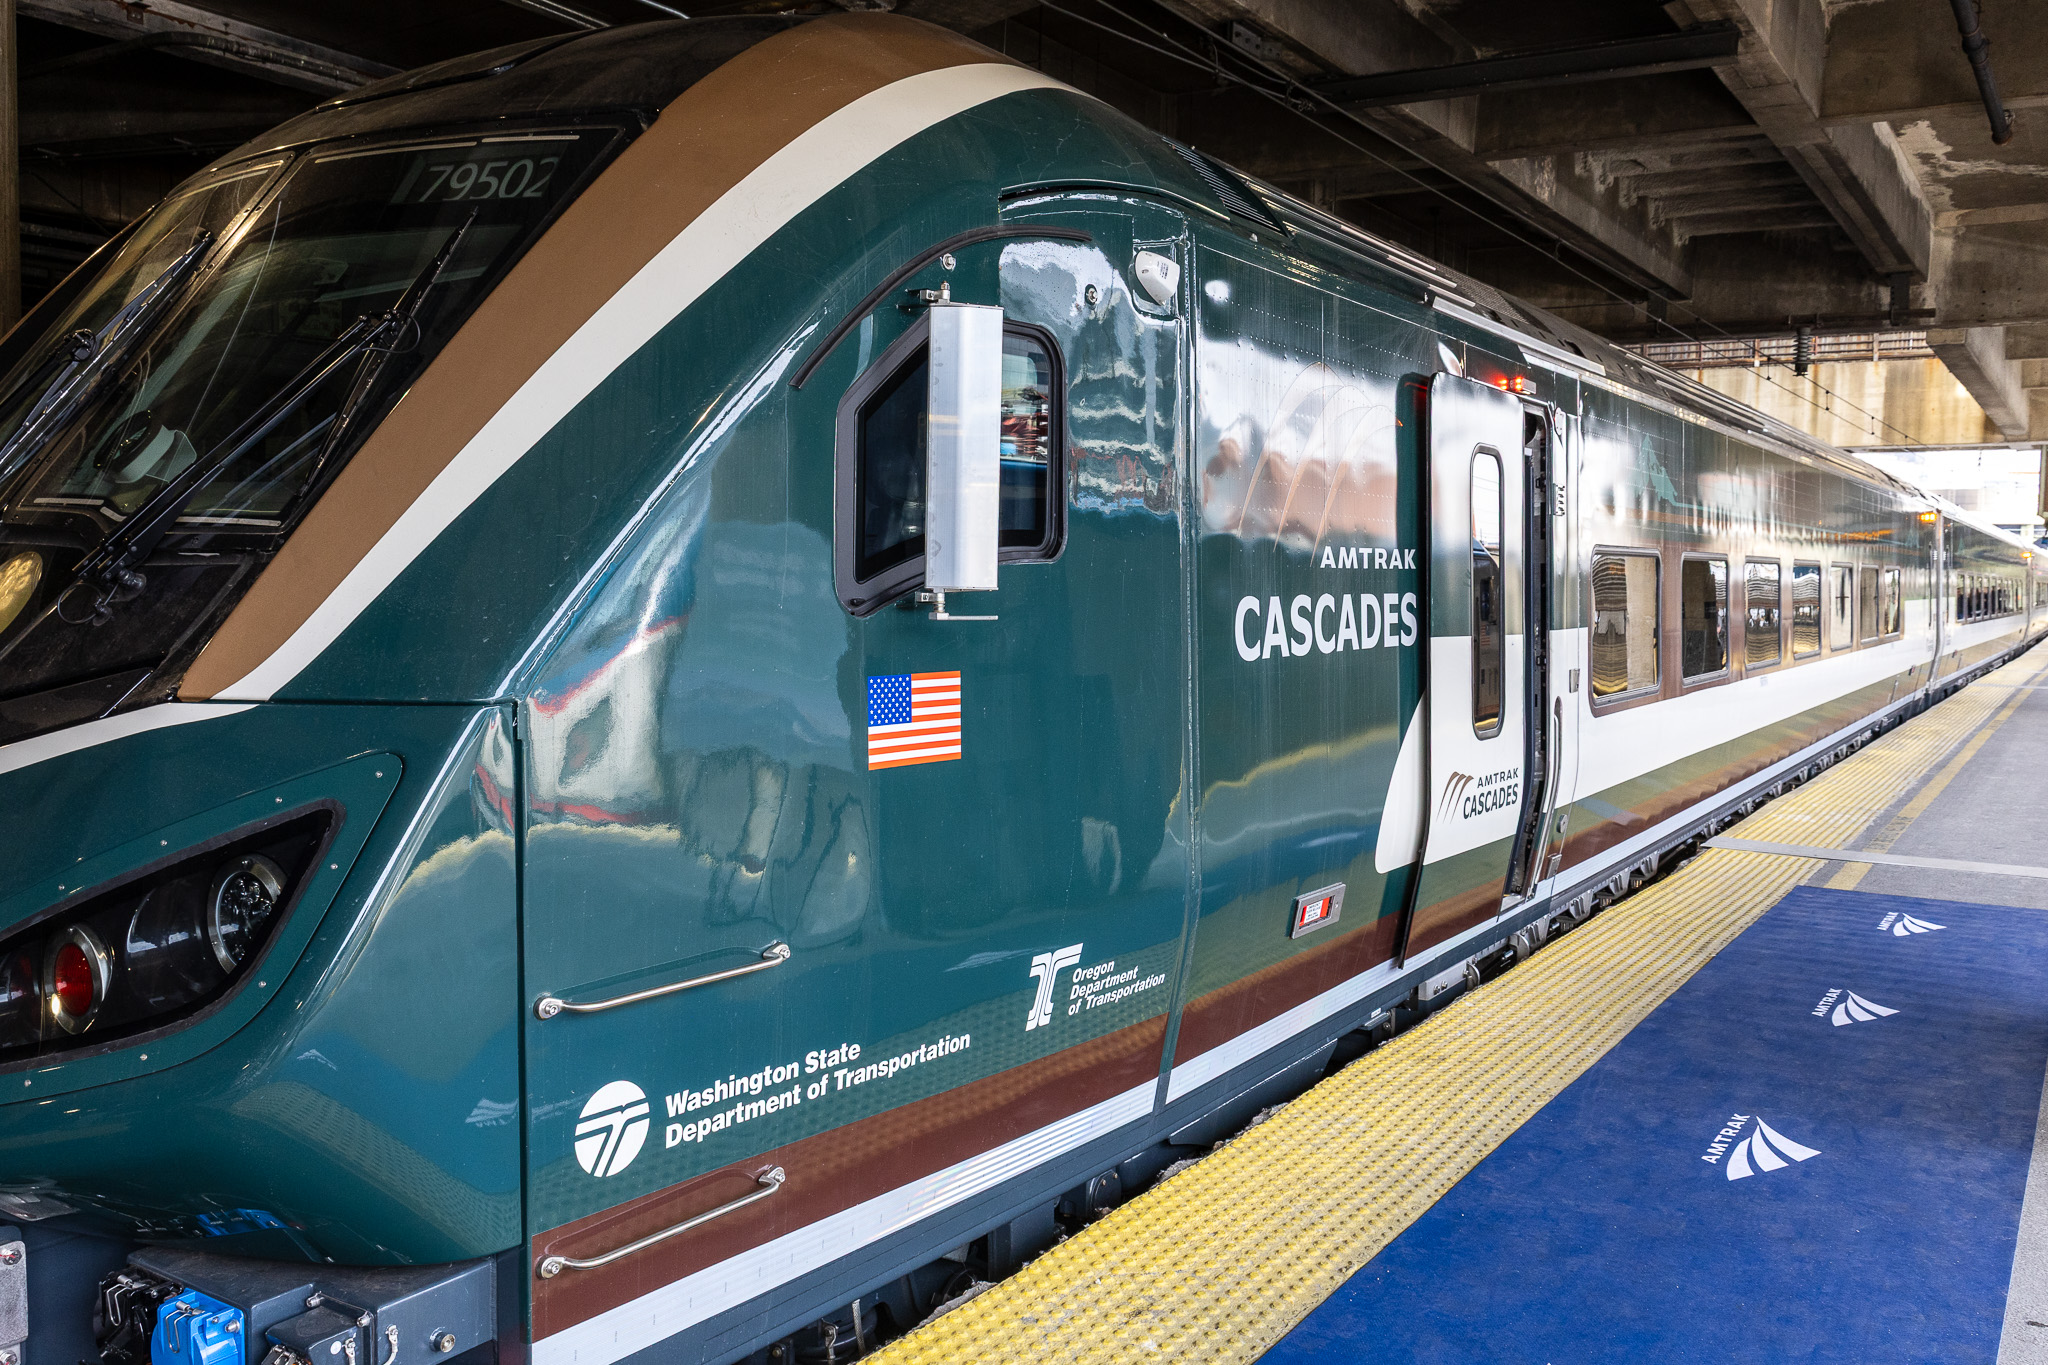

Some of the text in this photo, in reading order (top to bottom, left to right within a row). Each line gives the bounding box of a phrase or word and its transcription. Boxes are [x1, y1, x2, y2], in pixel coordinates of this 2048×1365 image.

[419, 157, 559, 202] 79502
[1320, 545, 1416, 570] AMTRAK
[1234, 591, 1418, 662] CASCADES
[1477, 767, 1519, 788] AMTRAK
[1463, 783, 1519, 820] CASCADES
[1876, 911, 1899, 931] AMTRAK
[1069, 965, 1139, 1000] Department
[1072, 960, 1115, 983] Oregon
[1068, 973, 1166, 1016] of Transportation
[1811, 988, 1843, 1017] AMTRAK
[665, 1042, 861, 1118] Washington State
[665, 1033, 970, 1149] Department of Transportation
[1701, 1113, 1750, 1164] AMTRAK
